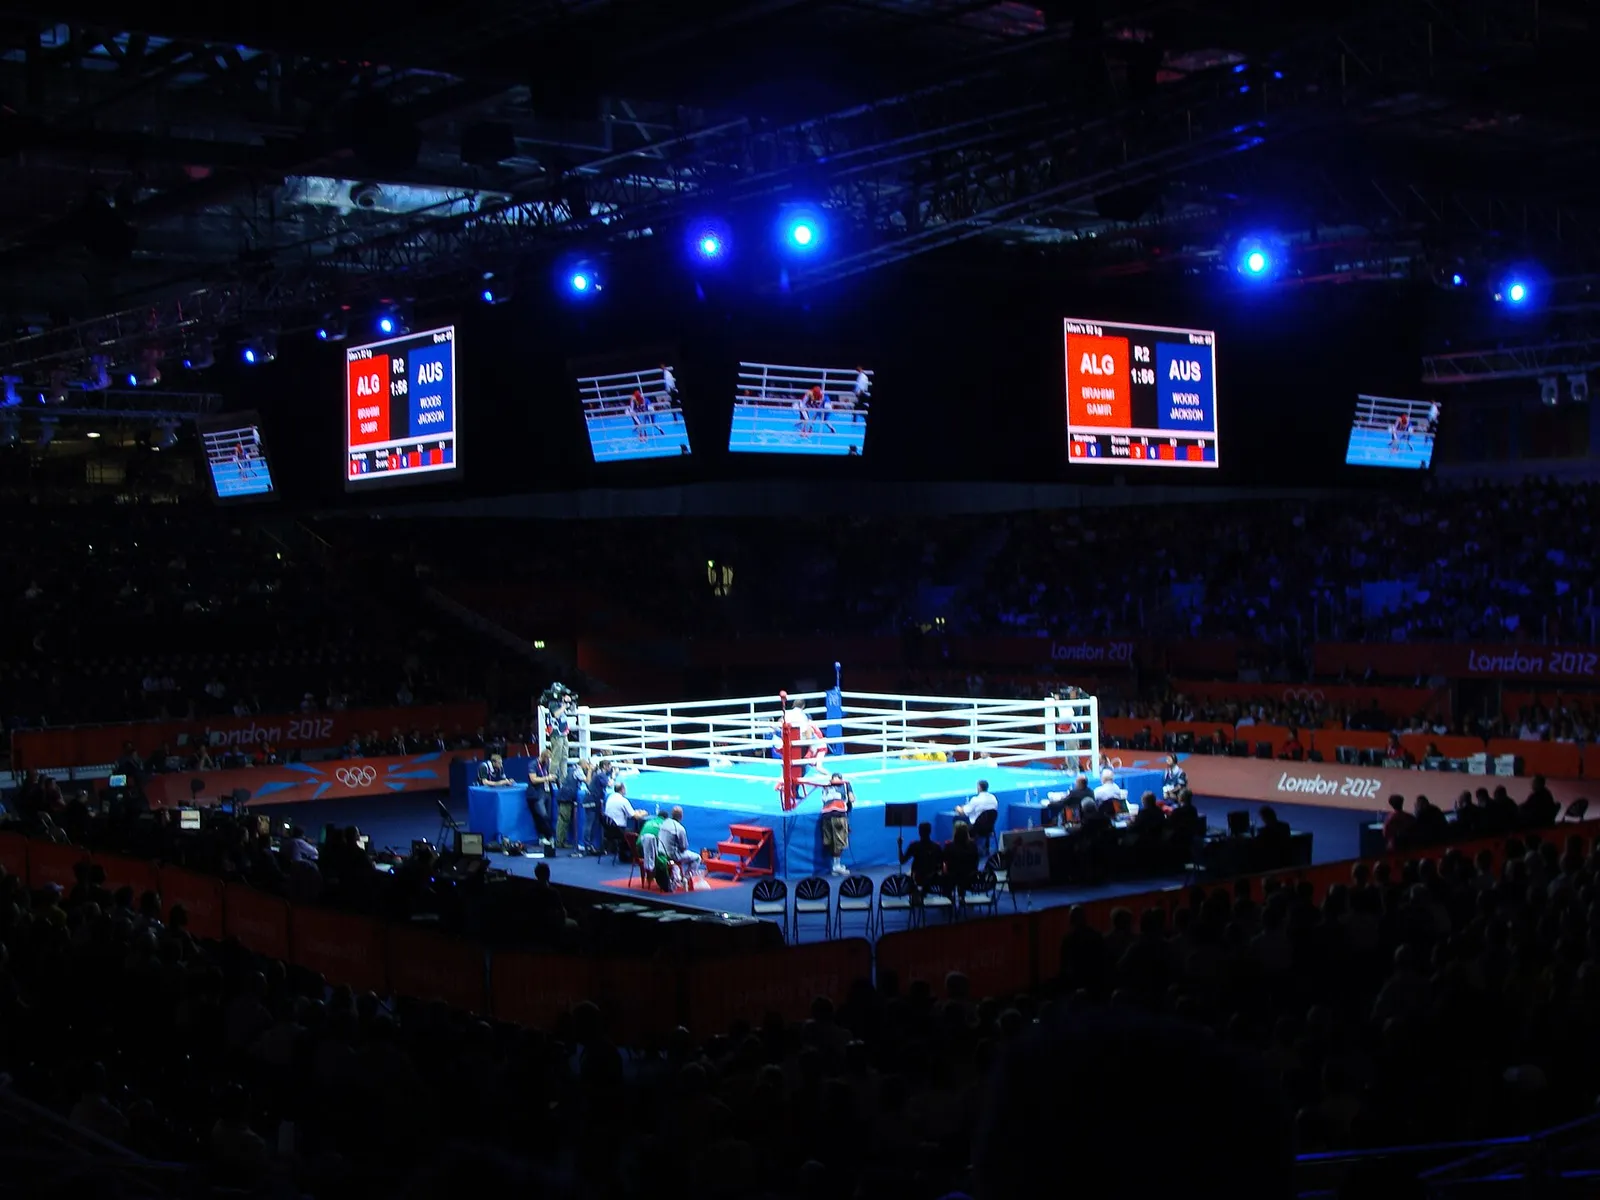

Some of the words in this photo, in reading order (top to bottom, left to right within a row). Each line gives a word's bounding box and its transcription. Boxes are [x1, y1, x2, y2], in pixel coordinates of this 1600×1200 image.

[1080, 352, 1115, 375] ALG
[1134, 346, 1150, 362] R2
[392, 358, 405, 374] R2
[417, 361, 443, 386] AUS
[1169, 359, 1202, 382] AUS
[357, 373, 381, 397] ALG
[419, 394, 442, 410] WOODS
[1086, 402, 1112, 416] SAMIR
[1172, 392, 1200, 406] WOODS
[417, 410, 445, 426] JACKSON
[1170, 407, 1204, 421] JACKSON
[1050, 640, 1105, 661] London
[1107, 641, 1135, 661] 201
[1468, 648, 1544, 673] London
[1548, 650, 1599, 676] 2012
[286, 718, 335, 741] 2012
[1276, 771, 1339, 796] London
[1340, 775, 1382, 799] 2012
